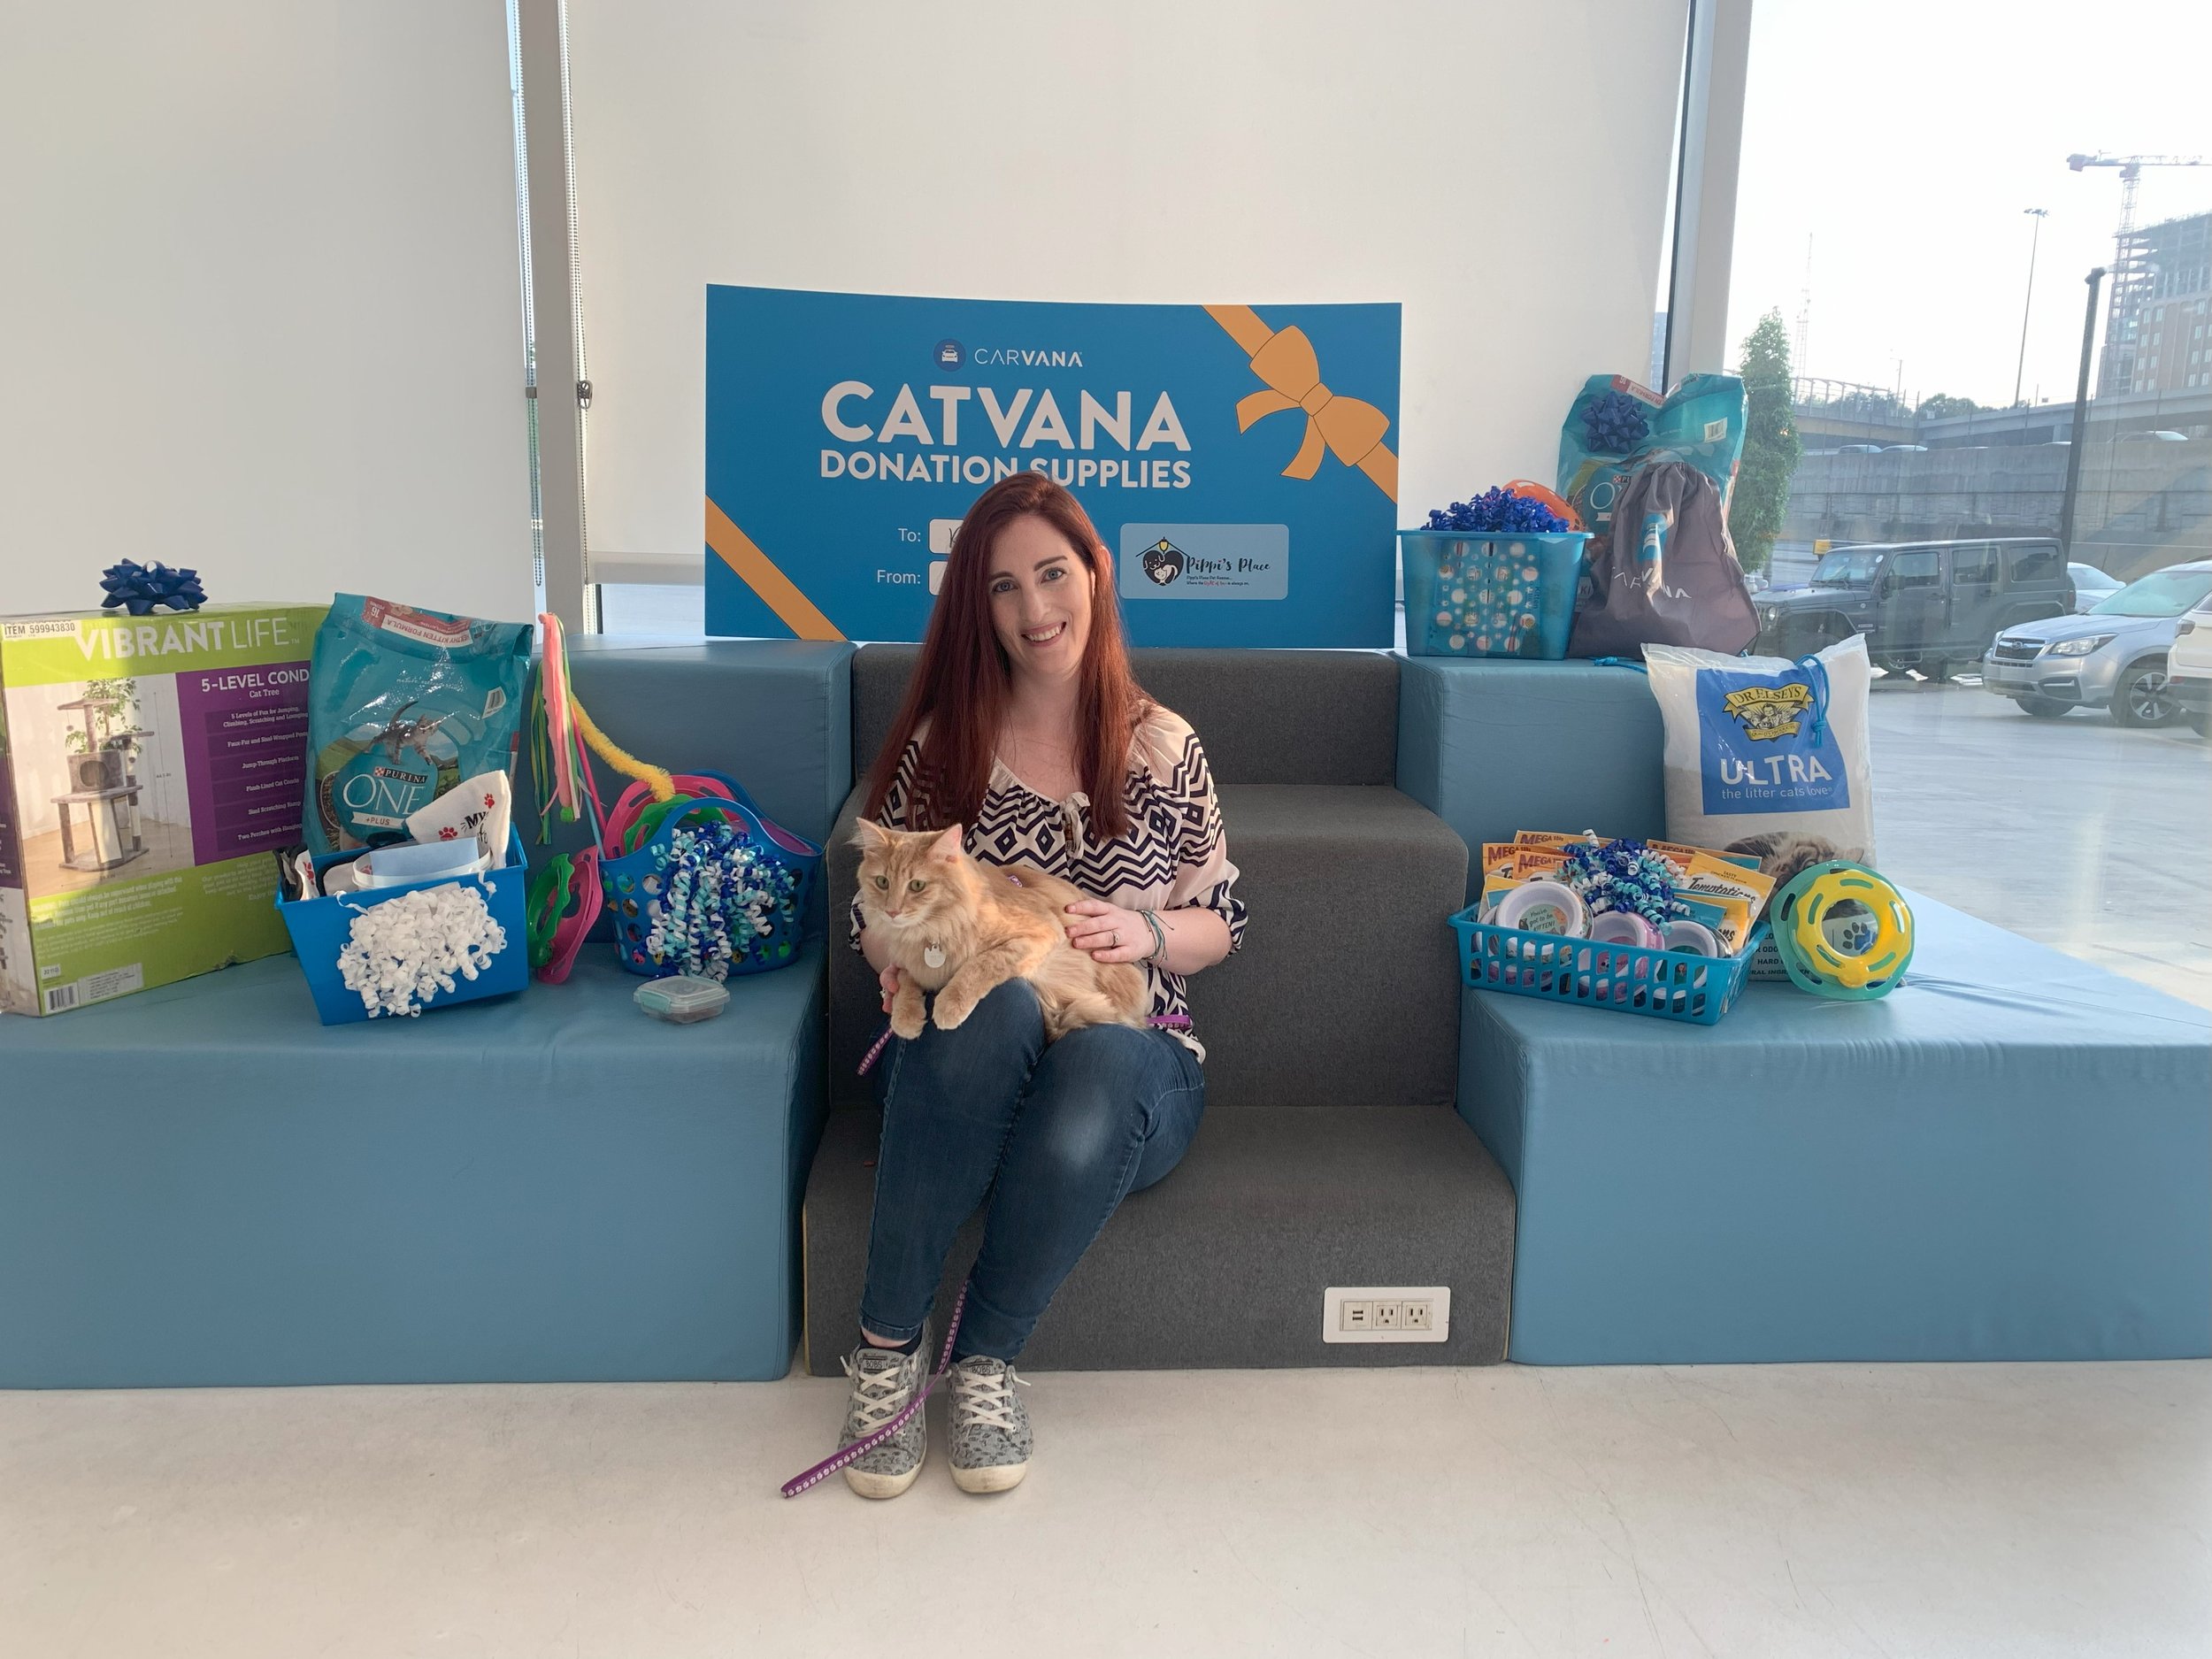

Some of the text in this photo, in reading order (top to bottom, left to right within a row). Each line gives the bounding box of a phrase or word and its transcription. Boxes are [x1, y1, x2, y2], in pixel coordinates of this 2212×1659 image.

[974, 348, 1083, 367] CARVANA
[821, 380, 1192, 451] CATVANA
[820, 449, 1191, 488] DONATION SUPPLIES
[897, 527, 921, 542] To:
[1187, 557, 1271, 574] Pippi's Place
[877, 569, 921, 584] From:
[371, 607, 380, 618] 16
[4, 622, 75, 635] ITEM 599943830
[386, 618, 422, 636] FORMULA
[74, 618, 289, 662] VIBRANT LIFE
[423, 631, 449, 643] KITTEN
[202, 668, 310, 692] 5-LEVEL COND
[263, 688, 280, 697] Tree
[385, 769, 426, 783] PURINA
[1720, 754, 1833, 786] ULTRA
[342, 773, 425, 815] ONE
[1722, 786, 1828, 799] the litter cats love
[365, 817, 390, 826] +PLUS
[1520, 833, 1553, 845] MEGA
[1488, 846, 1519, 865] MEGA
[1518, 853, 1552, 873] MEGA
[866, 1360, 883, 1369] BOBS
